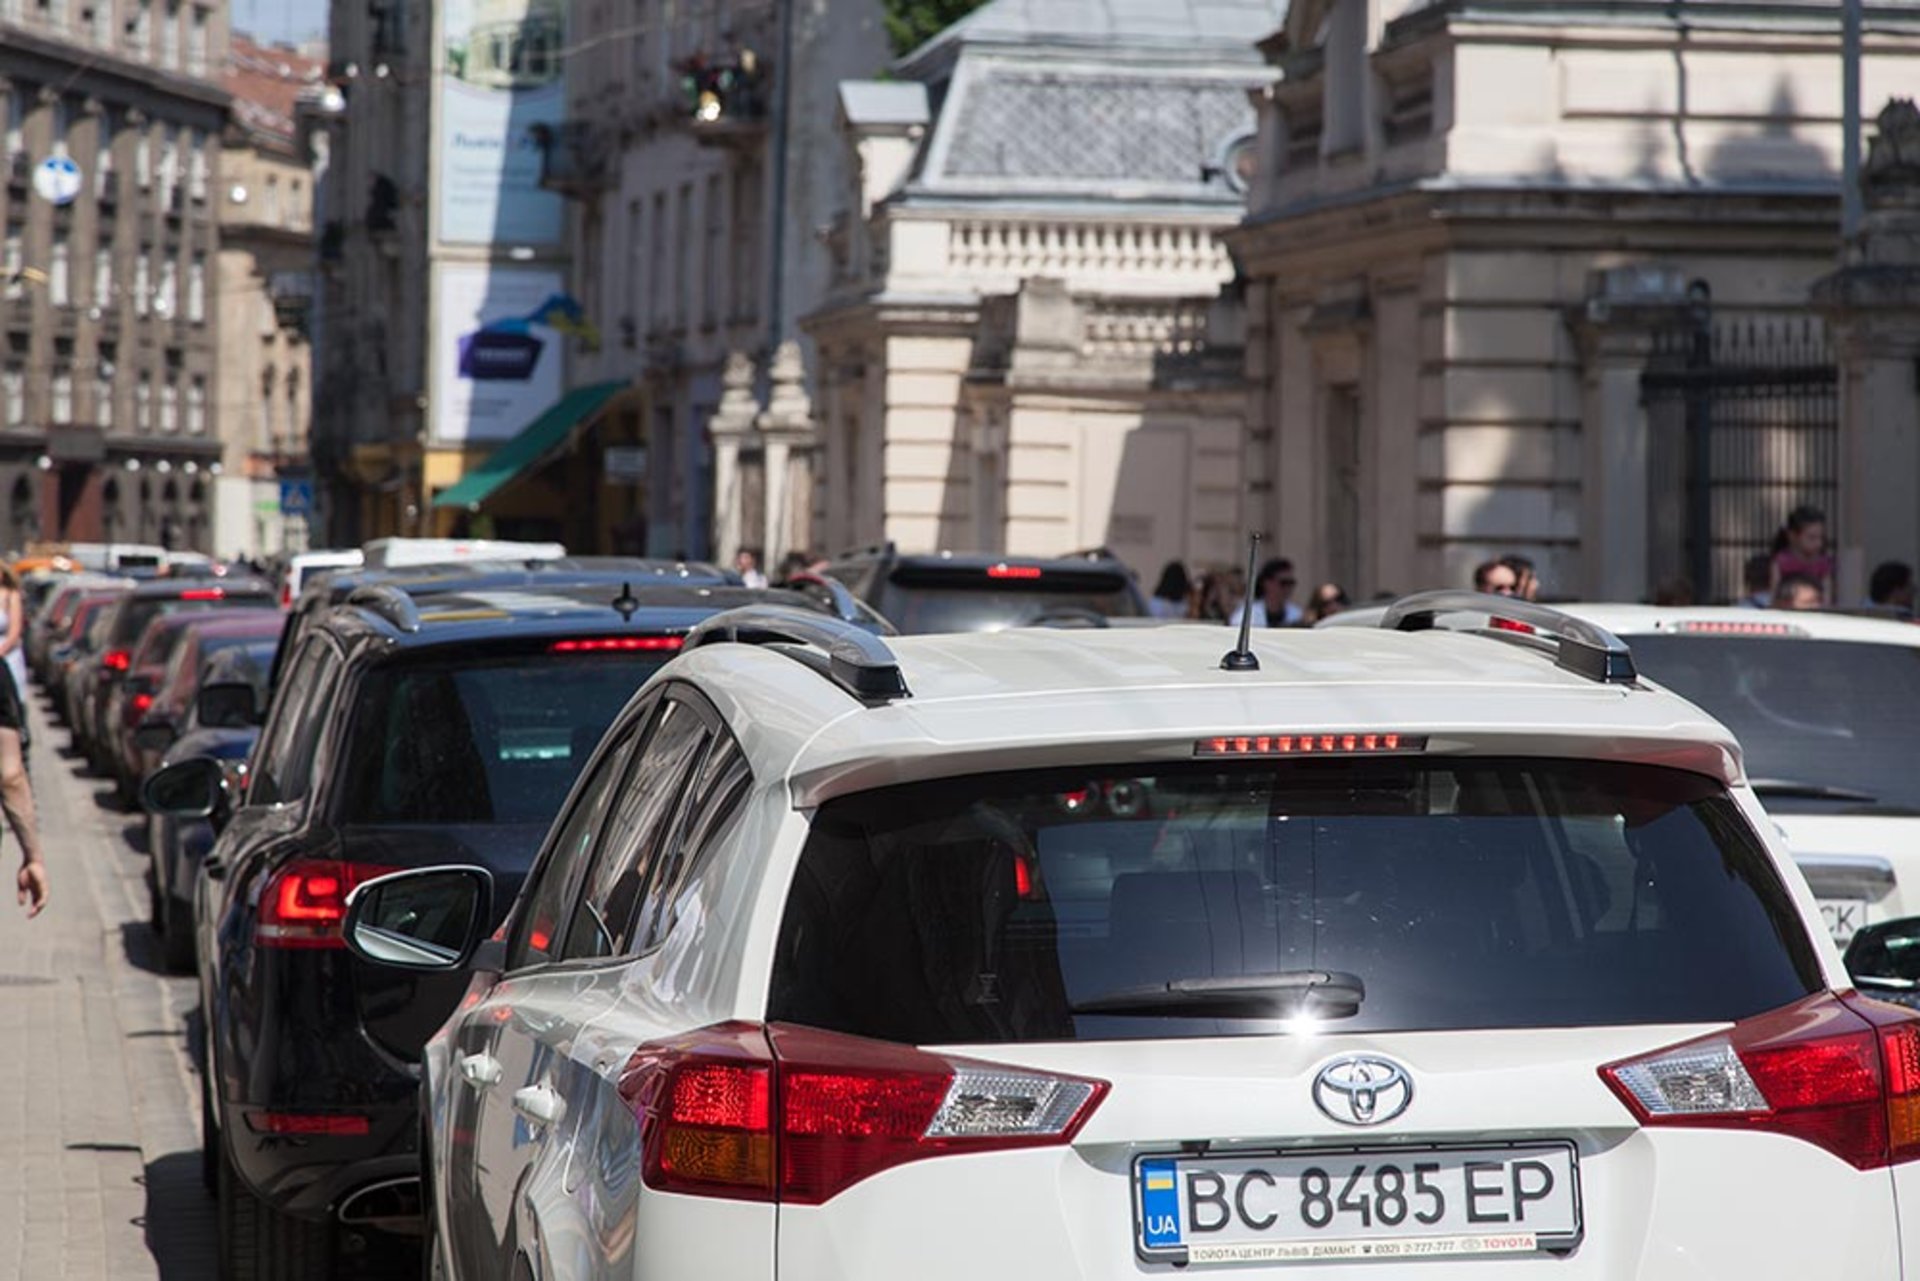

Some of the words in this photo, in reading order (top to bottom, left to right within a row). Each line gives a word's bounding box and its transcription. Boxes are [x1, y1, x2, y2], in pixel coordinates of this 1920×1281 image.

[1186, 1169, 1279, 1232] BC
[1300, 1163, 1445, 1229] 8485
[1463, 1160, 1554, 1223] EP
[1147, 1215, 1178, 1235] UA
[1483, 1237, 1533, 1249] TOYOTA
[1239, 1247, 1275, 1259] ЦЕНТР
